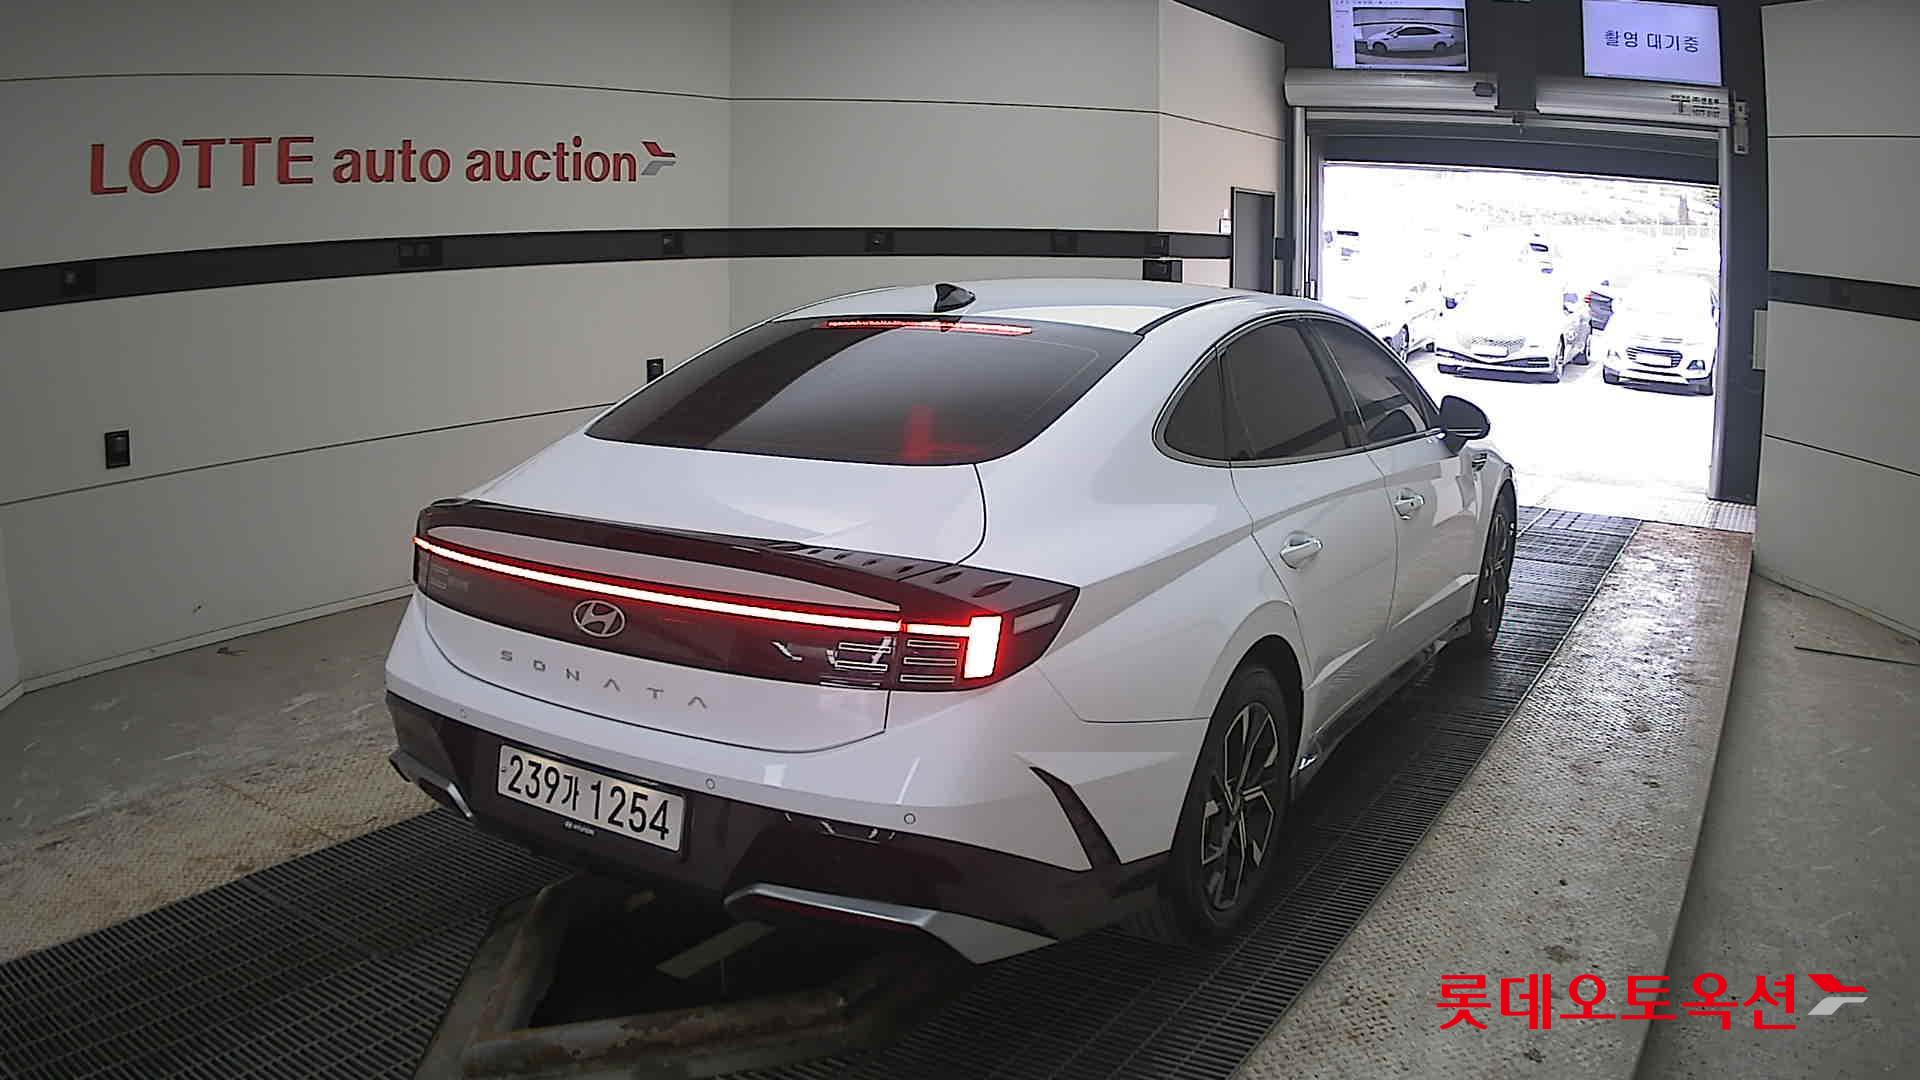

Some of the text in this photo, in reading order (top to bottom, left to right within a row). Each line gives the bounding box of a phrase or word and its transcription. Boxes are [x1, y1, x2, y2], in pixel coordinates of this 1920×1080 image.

[1605, 30, 1699, 53] 촬영 대기중
[90, 135, 638, 195] LOTTE auto auction
[500, 650, 707, 709] SONATA
[508, 755, 669, 840] 239가 1254
